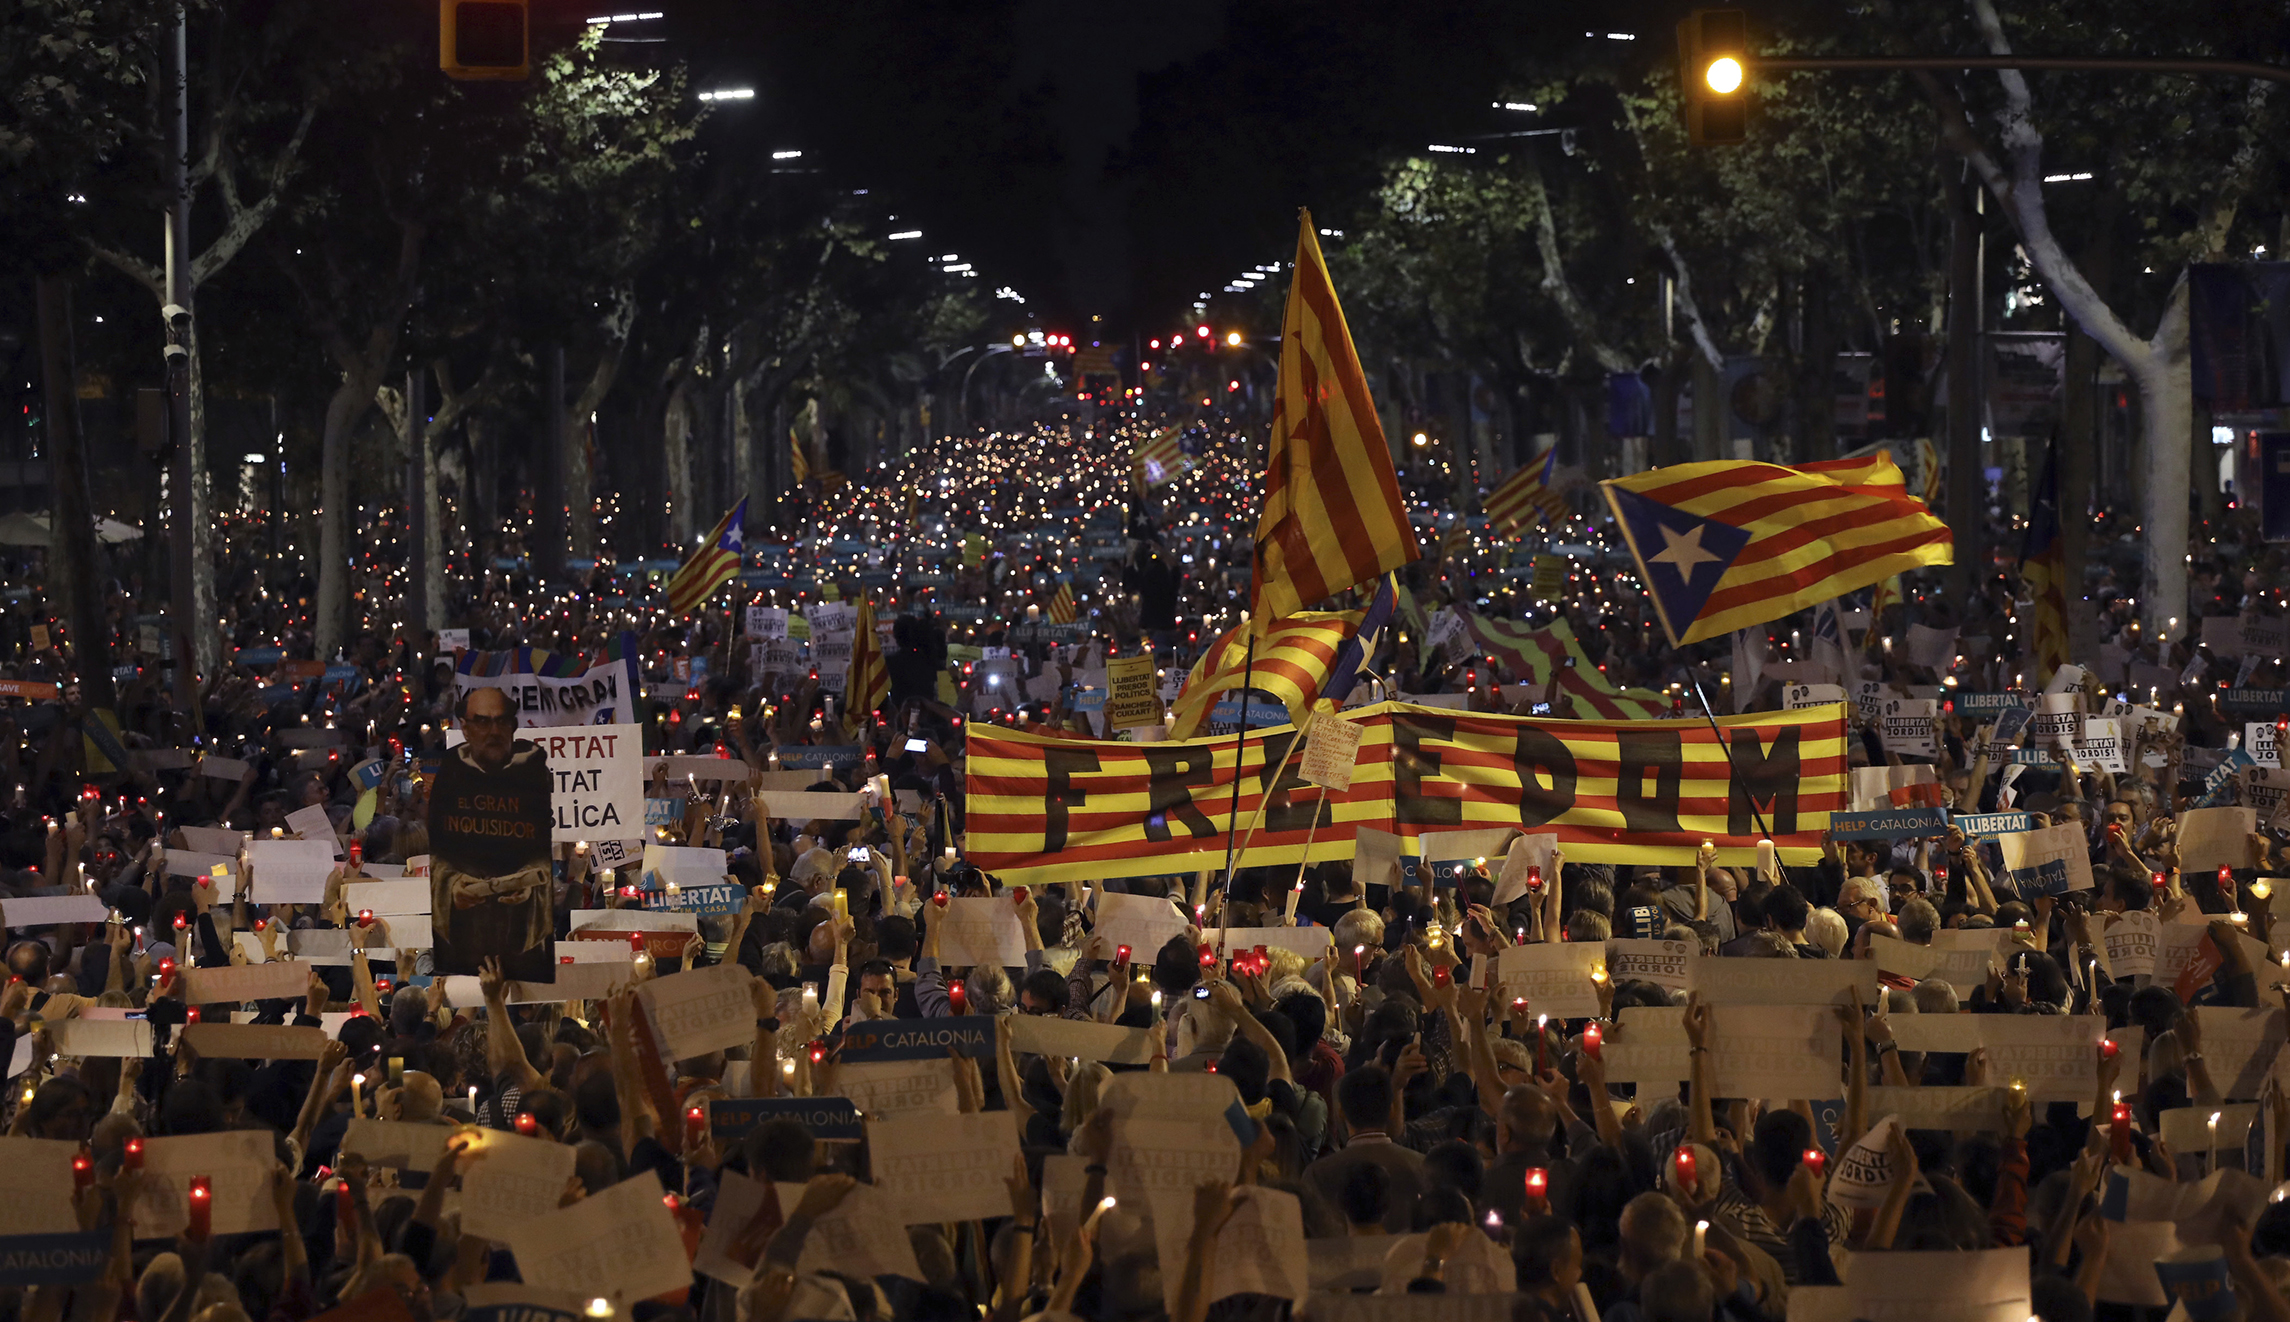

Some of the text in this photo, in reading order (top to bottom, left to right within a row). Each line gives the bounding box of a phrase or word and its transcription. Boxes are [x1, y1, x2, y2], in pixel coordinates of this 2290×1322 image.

[1016, 627, 1069, 638] LLIERTAT
[1112, 673, 1151, 685] LLIBERTAT
[1116, 681, 1148, 691] PRESOS
[1079, 695, 1103, 706] HELP
[1963, 693, 2019, 708] LLIBERTAT
[2227, 690, 2285, 704] LLIBERTAT
[1115, 707, 1151, 718] CUIXART
[1212, 706, 1235, 716] HELP
[1886, 717, 1931, 727] LLIBERTAT
[1886, 727, 1931, 736] JORDIS!
[778, 751, 858, 762] HELP CATALONIA
[2017, 750, 2057, 764] LLIB
[1044, 712, 1802, 854] FREEDOM
[458, 794, 520, 813] EL GRAN
[443, 816, 535, 839] INQUISIDOR
[1834, 815, 1943, 833] HELP CATALONIA
[1964, 814, 2027, 834] LLIBERTAT
[882, 1028, 986, 1050] CATALONIA
